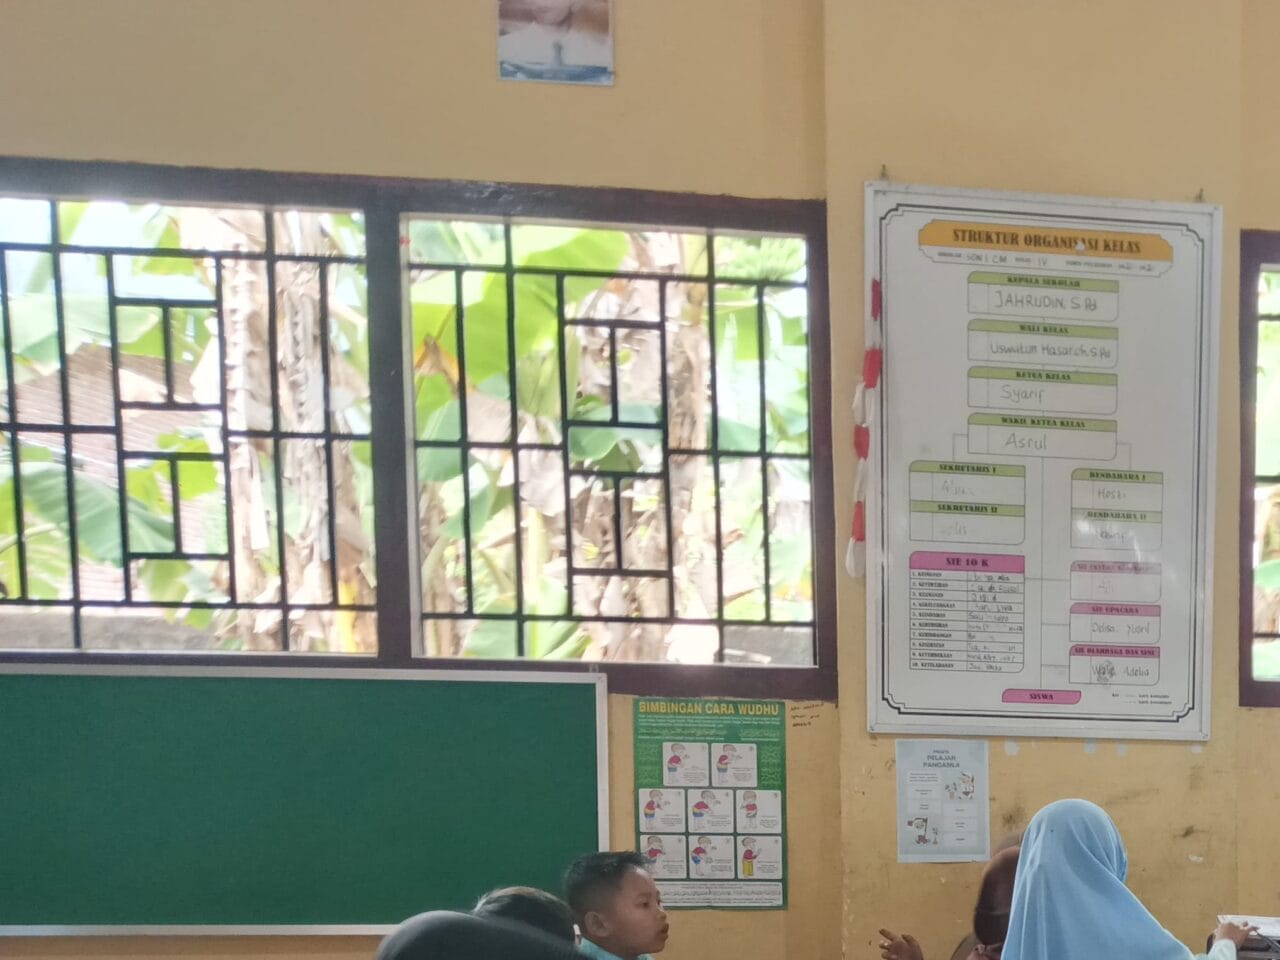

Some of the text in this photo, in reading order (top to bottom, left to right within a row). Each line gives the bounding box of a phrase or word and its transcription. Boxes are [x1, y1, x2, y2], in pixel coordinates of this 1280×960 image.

[953, 229, 1019, 246] STRUKTUR
[1103, 239, 1141, 253] KELAS
[1019, 324, 1069, 334] WALI KELAS
[1016, 371, 1071, 380] KETUA KELAS
[1000, 384, 1045, 403] Syarif
[1000, 417, 1086, 428] WAKIL KETUA KELAS
[1004, 432, 1047, 450] Asrul
[939, 464, 990, 473] SEKRETARIS
[1089, 471, 1139, 481] BENDAHARA
[937, 504, 988, 513] SEKRETARIS
[1087, 511, 1137, 520] BENDAHARA
[946, 558, 989, 567] SIE 10 K
[1029, 693, 1054, 701] SISWA
[639, 701, 779, 715] BIMBINGAN CARA WUDHU
